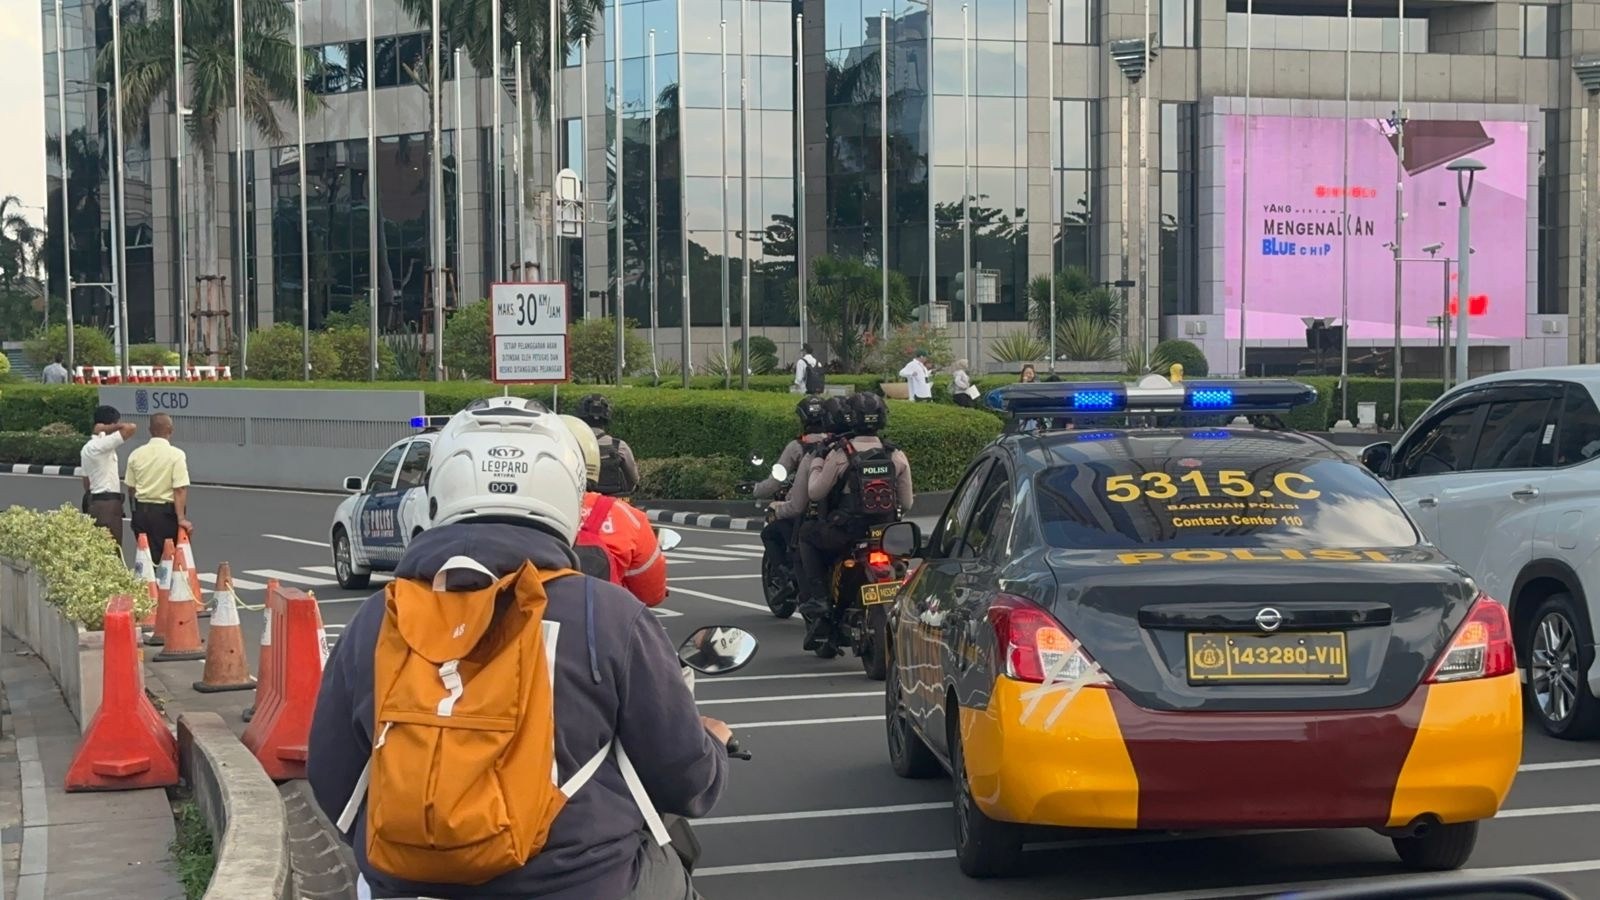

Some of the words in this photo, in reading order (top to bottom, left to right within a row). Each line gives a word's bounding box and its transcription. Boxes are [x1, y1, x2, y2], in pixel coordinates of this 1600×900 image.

[1263, 204, 1292, 213] YANG
[1264, 214, 1374, 236] MENGENALKAN
[1262, 237, 1296, 256] BLUE
[1300, 244, 1331, 256] CHIP
[516, 293, 537, 326] 30
[152, 392, 189, 409] SCBD
[491, 448, 521, 457] KYT
[481, 460, 529, 474] LEOPARD
[863, 466, 888, 474] POLISI
[491, 483, 515, 492] DOT
[1105, 470, 1321, 502] 5315.C
[1167, 502, 1245, 510] BANTUAN
[1248, 502, 1300, 510] POLISI
[371, 508, 394, 530] POLISI
[1172, 516, 1229, 527] Contact
[1231, 514, 1278, 525] Center
[1281, 515, 1303, 526] 110
[1116, 548, 1392, 565] POLISI
[1232, 646, 1341, 665] 143280-VII
